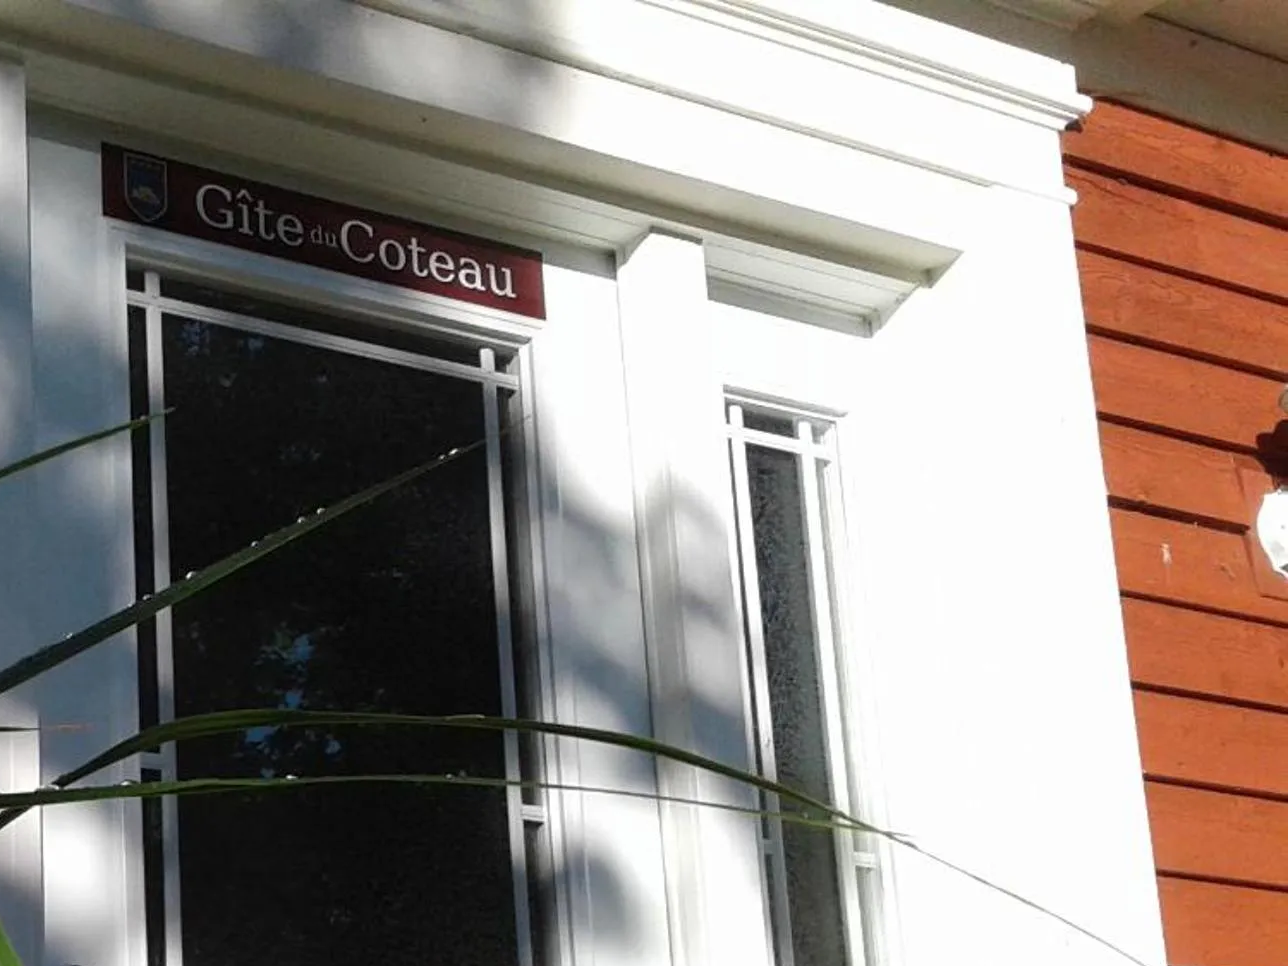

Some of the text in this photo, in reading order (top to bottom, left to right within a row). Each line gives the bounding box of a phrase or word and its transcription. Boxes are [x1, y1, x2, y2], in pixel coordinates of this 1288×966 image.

[196, 184, 517, 299] Gîte du Coteau
